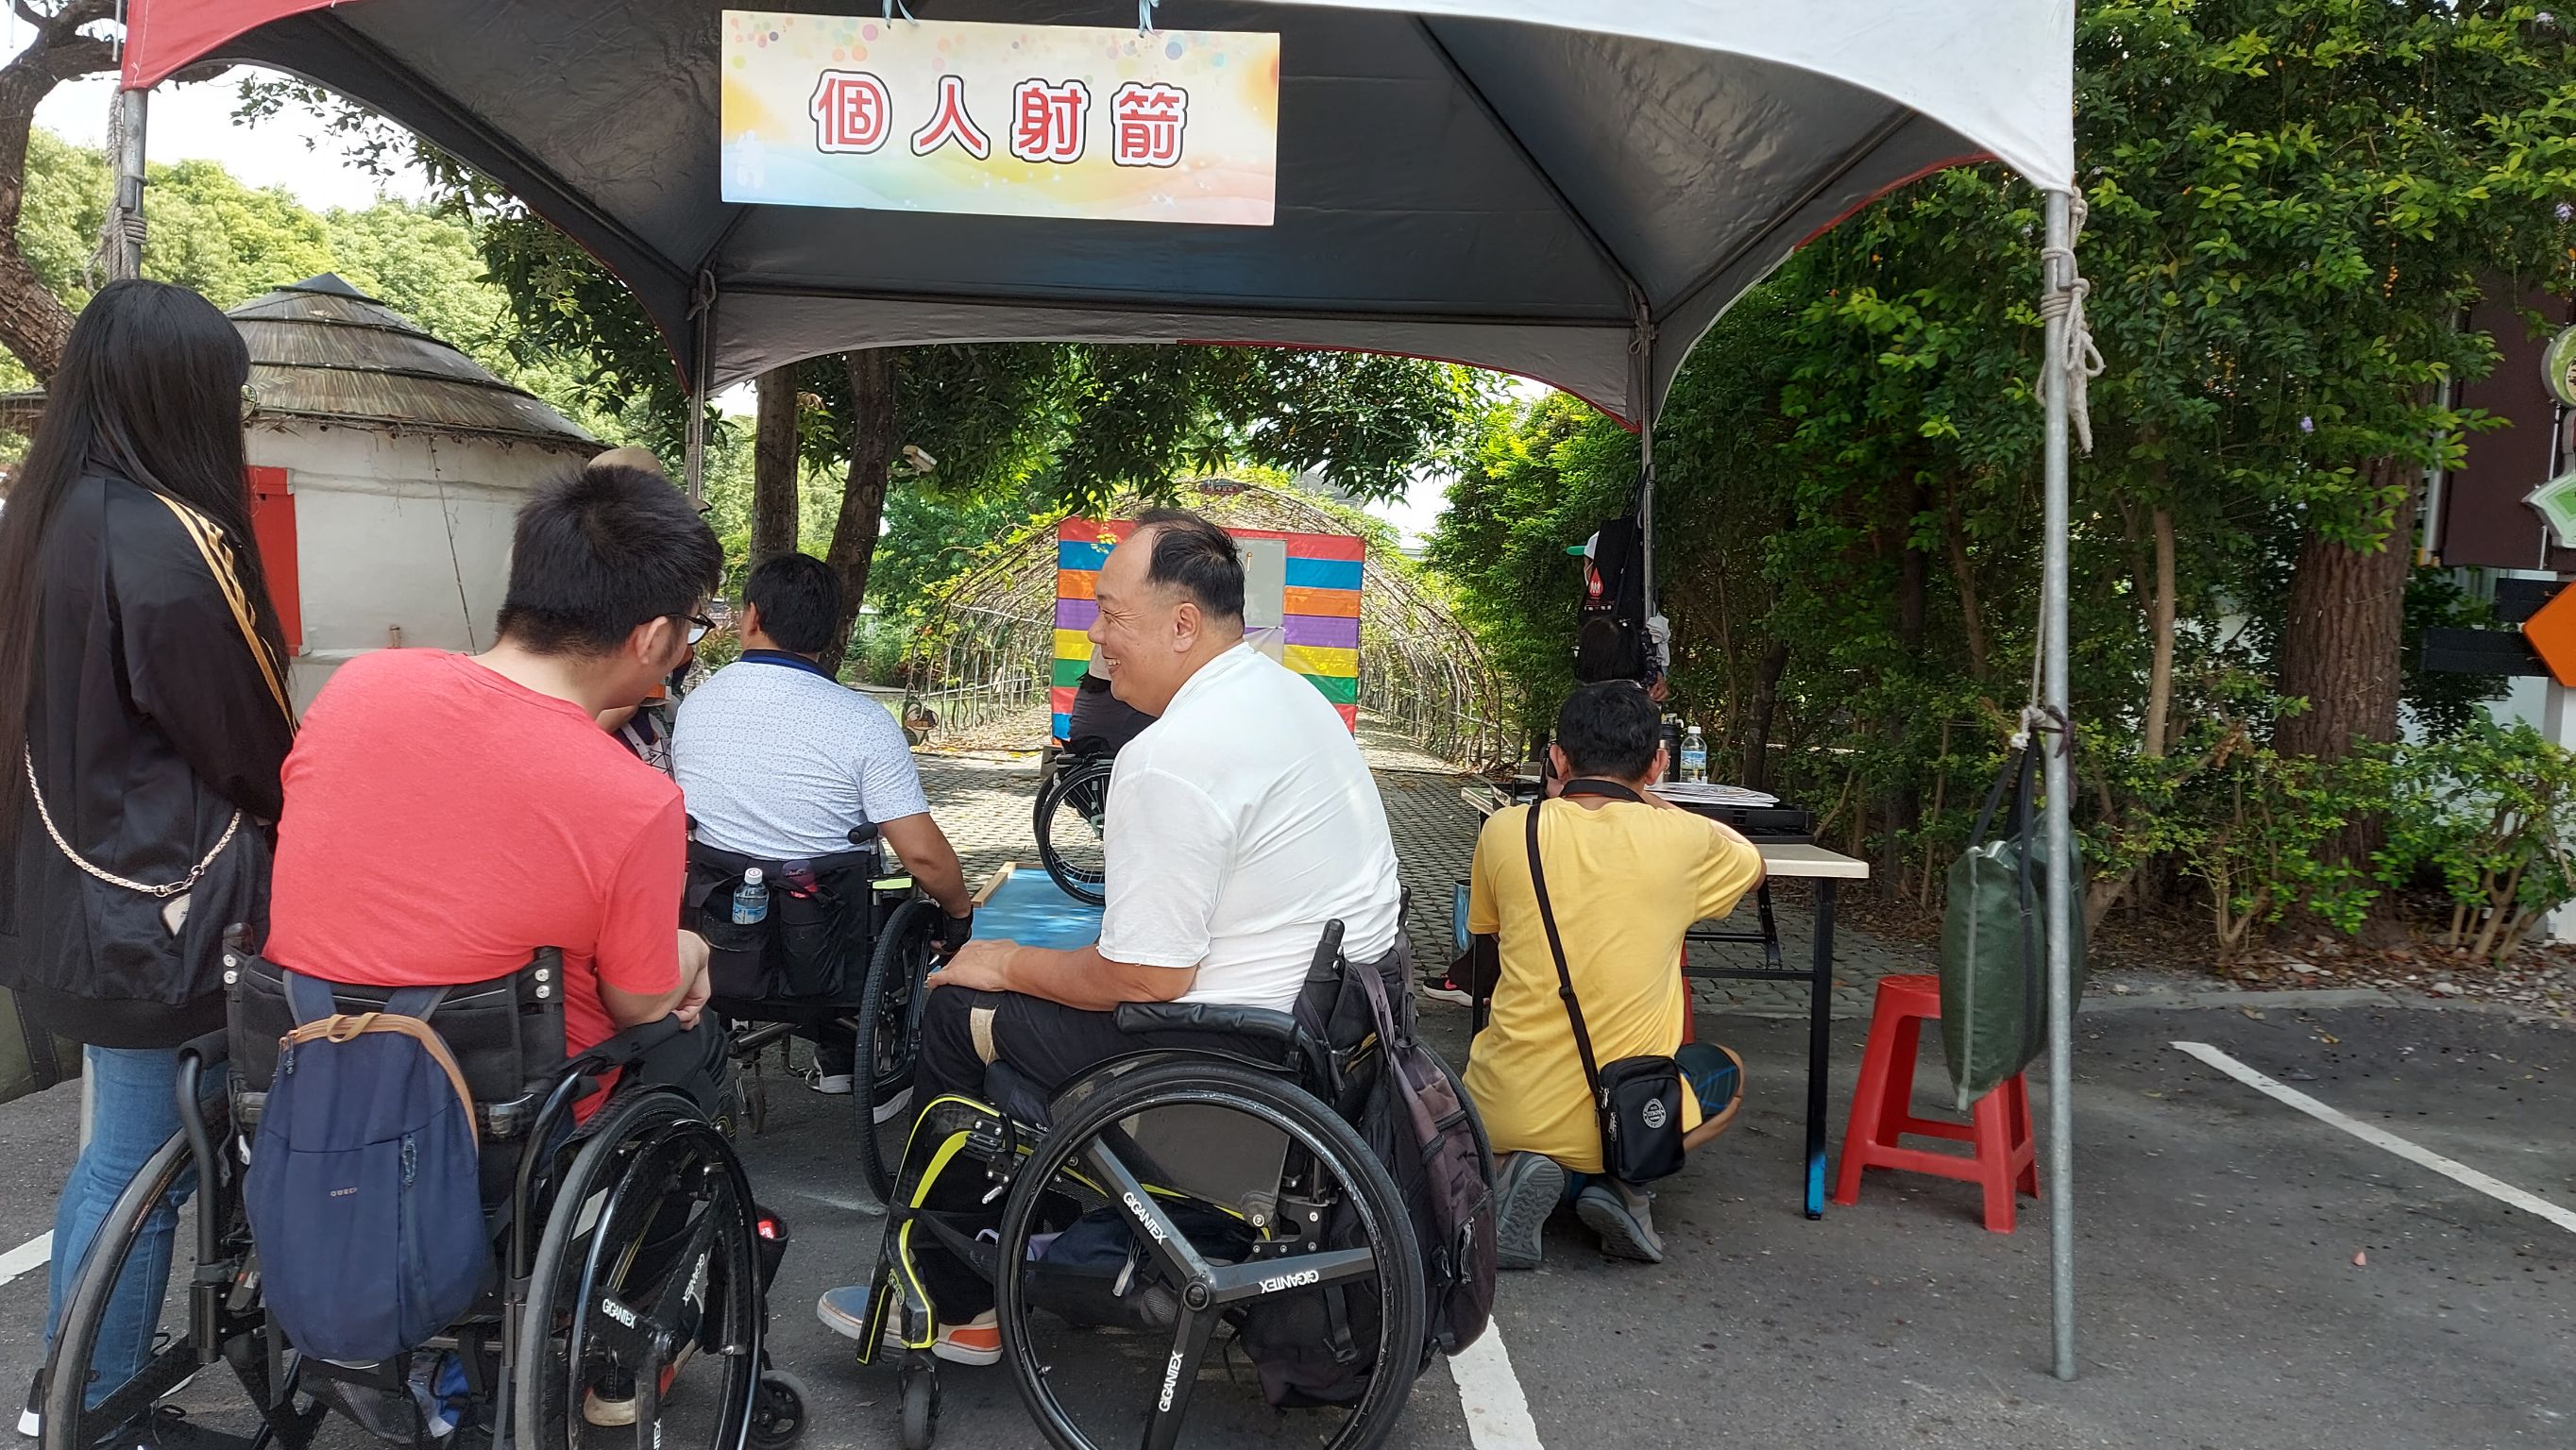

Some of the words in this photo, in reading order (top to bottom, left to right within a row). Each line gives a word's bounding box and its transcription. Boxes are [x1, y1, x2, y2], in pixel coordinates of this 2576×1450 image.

[810, 70, 1188, 167] 個人射箭
[1124, 1191, 1167, 1245] GIGANTEX
[1259, 1270, 1319, 1293] GIGANTEX
[602, 1298, 637, 1329] GIGANTEX
[1158, 1350, 1183, 1412] GIGANTEX
